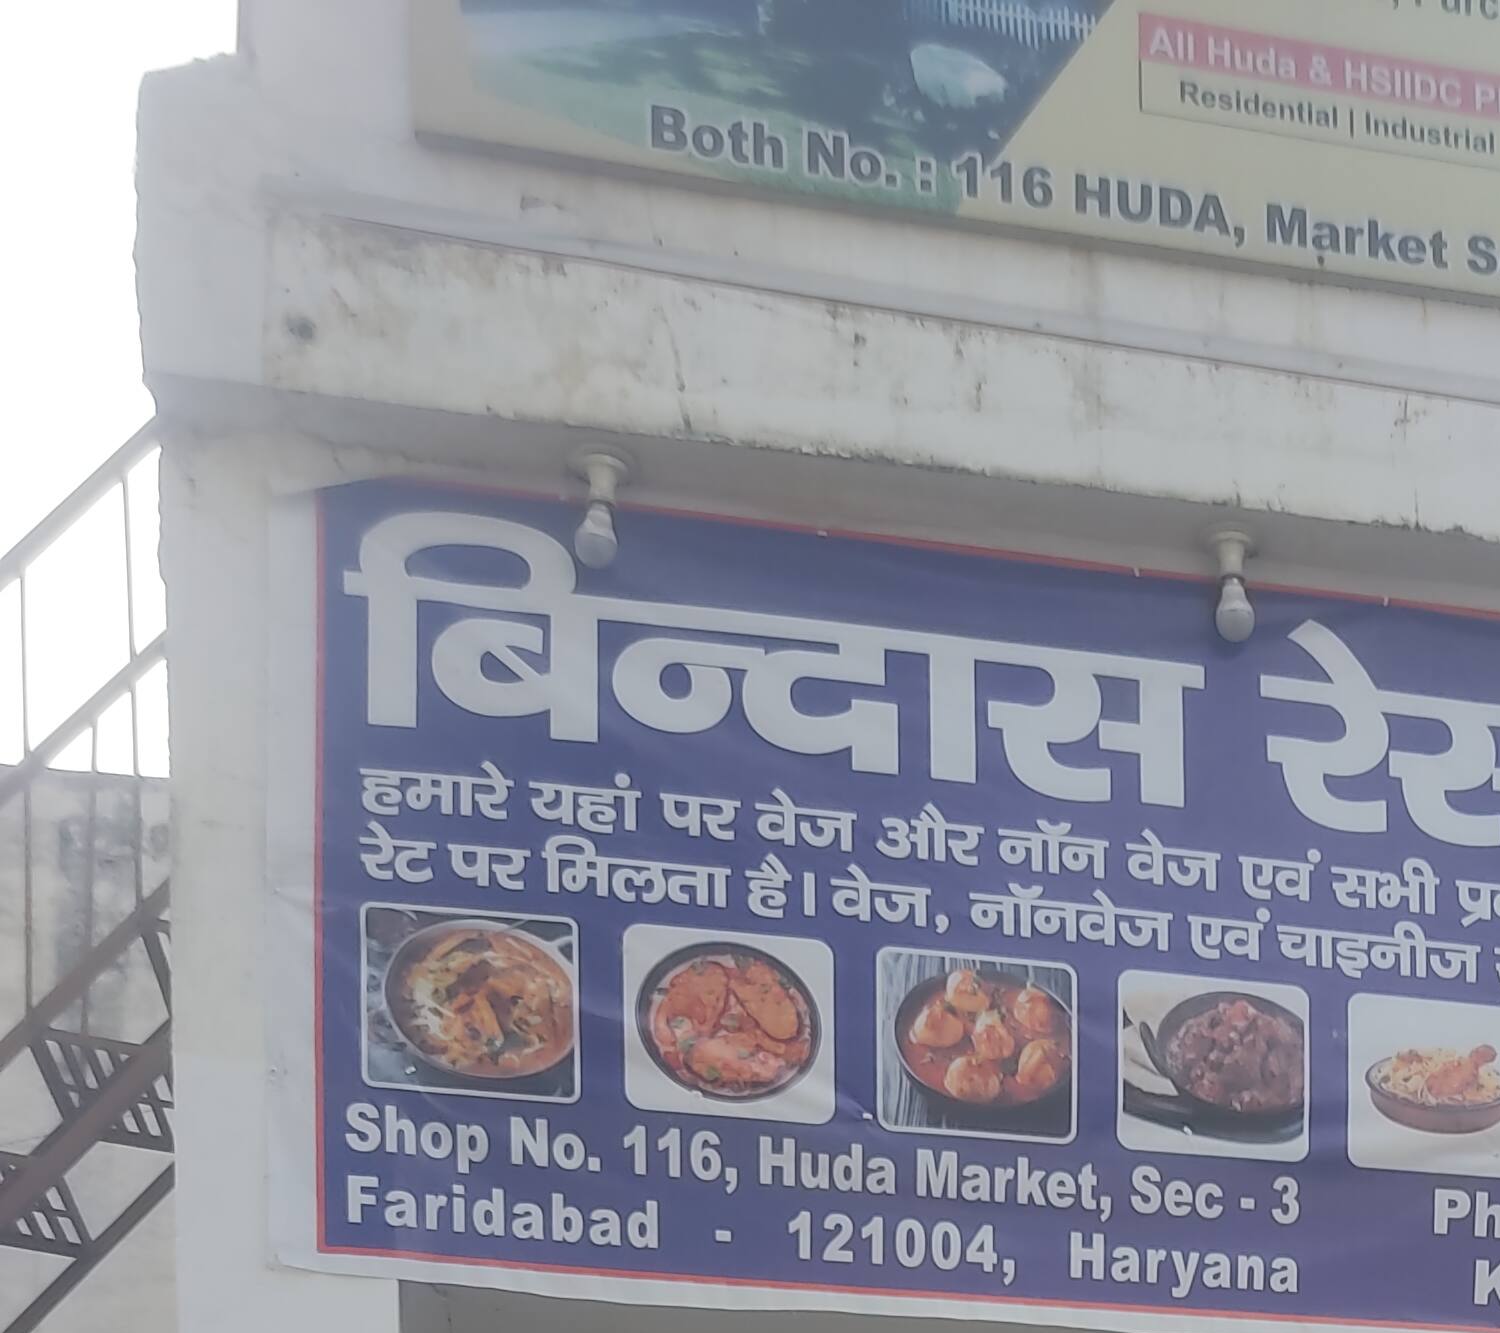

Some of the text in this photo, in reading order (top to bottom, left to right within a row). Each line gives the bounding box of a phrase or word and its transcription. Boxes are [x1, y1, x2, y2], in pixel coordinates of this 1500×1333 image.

[1148, 27, 1194, 62] All
[1207, 37, 1297, 80] Huda
[1308, 54, 1334, 87] &
[1344, 61, 1463, 107] HSIIDC
[1179, 80, 1338, 130] Residential
[1365, 111, 1495, 155] Industrial
[649, 104, 786, 171] Both
[807, 131, 902, 191] No.
[955, 154, 1055, 209] 116
[1073, 173, 1246, 248] HUDA,
[1265, 202, 1449, 271] Market
[342, 511, 1206, 810] बिन्दास
[359, 760, 514, 821] हमारे
[528, 772, 642, 835] यहां
[659, 791, 742, 842] पर
[755, 787, 857, 853] वेज
[875, 802, 985, 866] और
[998, 818, 1109, 880] नॉन
[1125, 828, 1221, 892] वेज
[1238, 848, 1323, 903] एवं
[1331, 857, 1440, 916] सभी
[359, 821, 437, 884] रेट
[447, 843, 531, 891] पर
[542, 834, 732, 909] मिलता
[829, 863, 950, 935] वेज,
[968, 882, 1174, 952] नॉनवेज
[1187, 906, 1271, 961] एवं
[1276, 920, 1481, 984] चाइनीज
[344, 1102, 489, 1175] Shop
[510, 1116, 602, 1172] No.
[622, 1125, 739, 1195] 116,
[757, 1135, 897, 1196] Huda
[915, 1149, 1113, 1222] Market,
[1129, 1164, 1225, 1220] Sec
[1270, 1175, 1301, 1225] 3
[346, 1174, 660, 1250] Faridabad
[787, 1210, 1017, 1287] 121004,
[1069, 1231, 1300, 1298] Haryana
